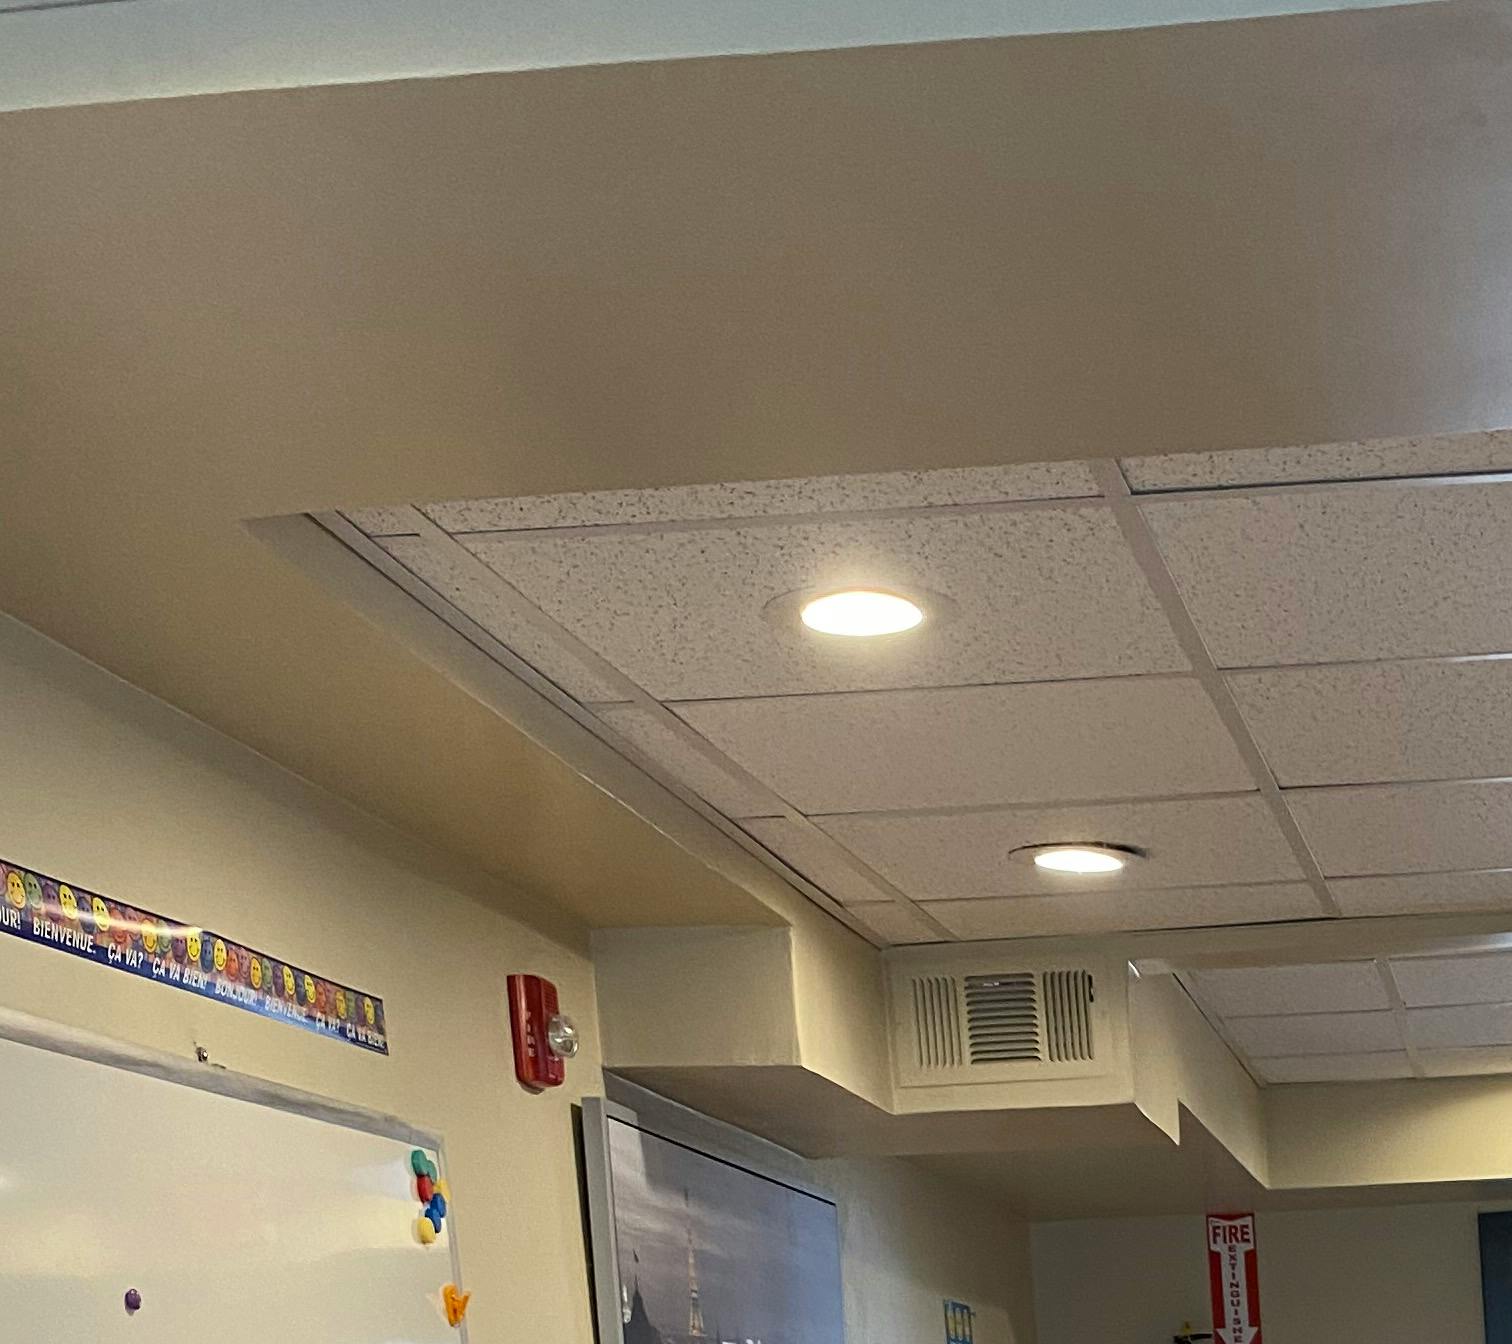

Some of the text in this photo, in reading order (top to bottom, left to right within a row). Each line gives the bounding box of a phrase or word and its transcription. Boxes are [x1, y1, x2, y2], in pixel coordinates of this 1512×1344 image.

[0, 903, 21, 930] UR!
[33, 916, 96, 954] BIENVENUE.
[125, 948, 144, 969] VA?
[169, 965, 181, 981] VA
[1212, 1225, 1251, 1244] FIRE
